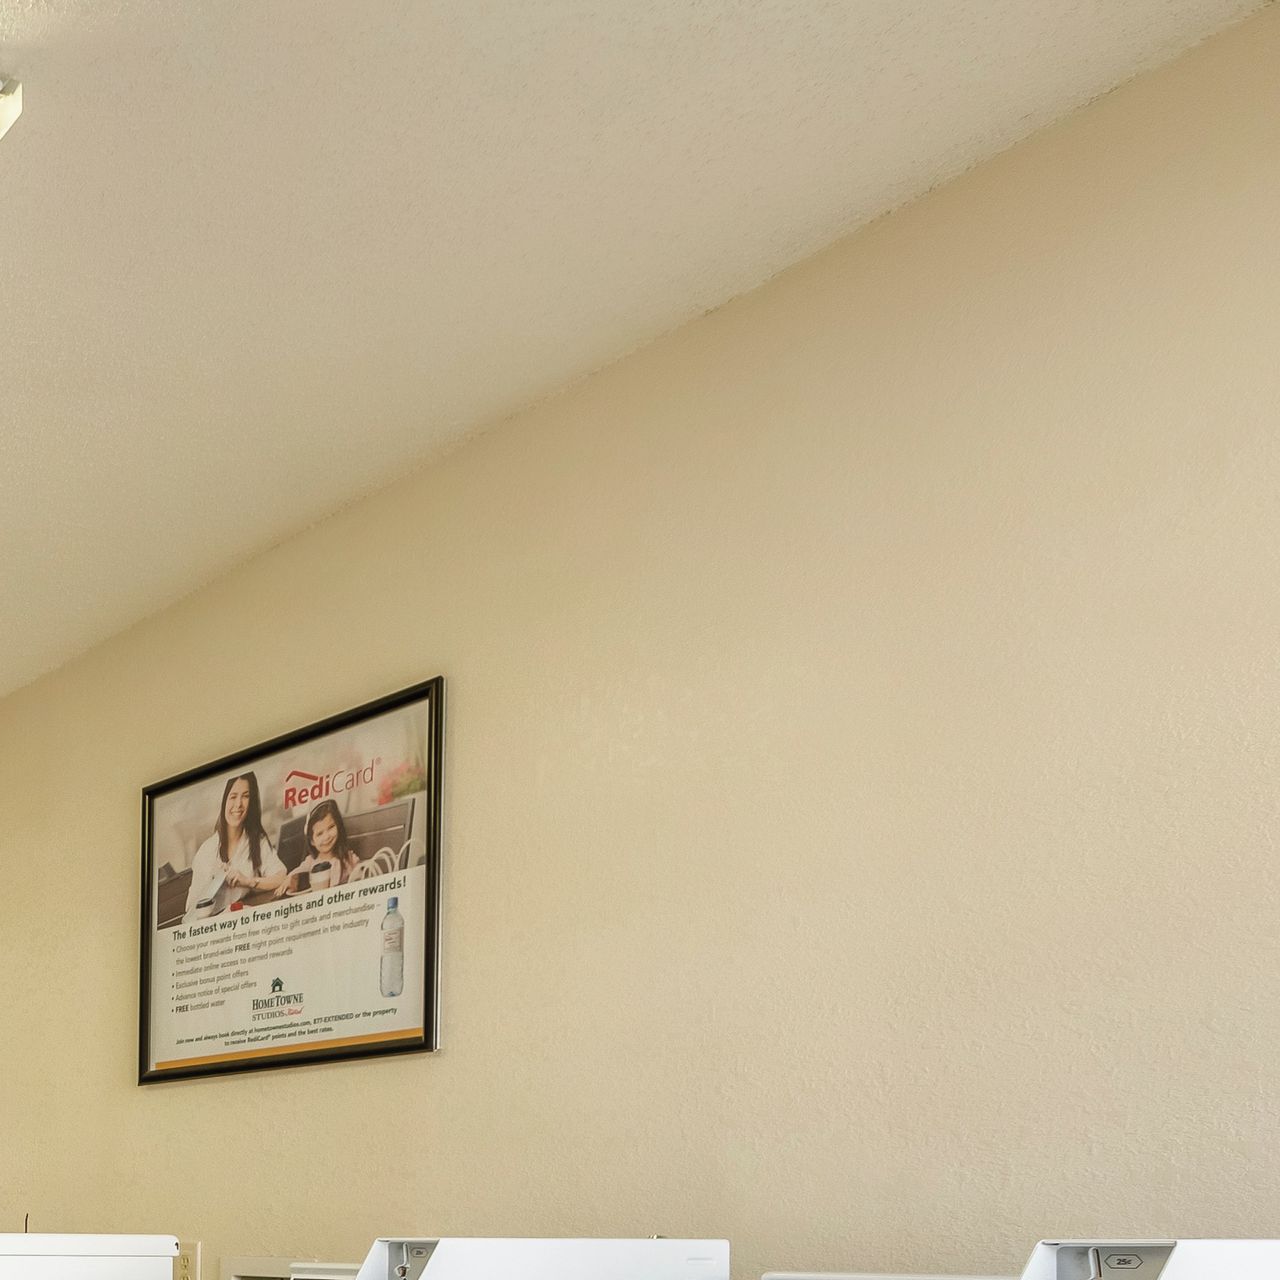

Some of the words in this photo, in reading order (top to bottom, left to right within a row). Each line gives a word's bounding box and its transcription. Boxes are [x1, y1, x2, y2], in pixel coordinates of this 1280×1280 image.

[173, 930, 186, 941] The
[189, 923, 217, 937] fastest
[220, 919, 238, 930] way
[241, 915, 250, 925] to
[253, 911, 272, 922] free
[274, 903, 303, 918] nights
[306, 895, 324, 909] and
[327, 891, 355, 905] other
[358, 876, 407, 898] rewards!
[235, 942, 251, 953] FREE
[175, 1003, 189, 1013] FREE
[252, 1010, 285, 1021] STUDIOS
